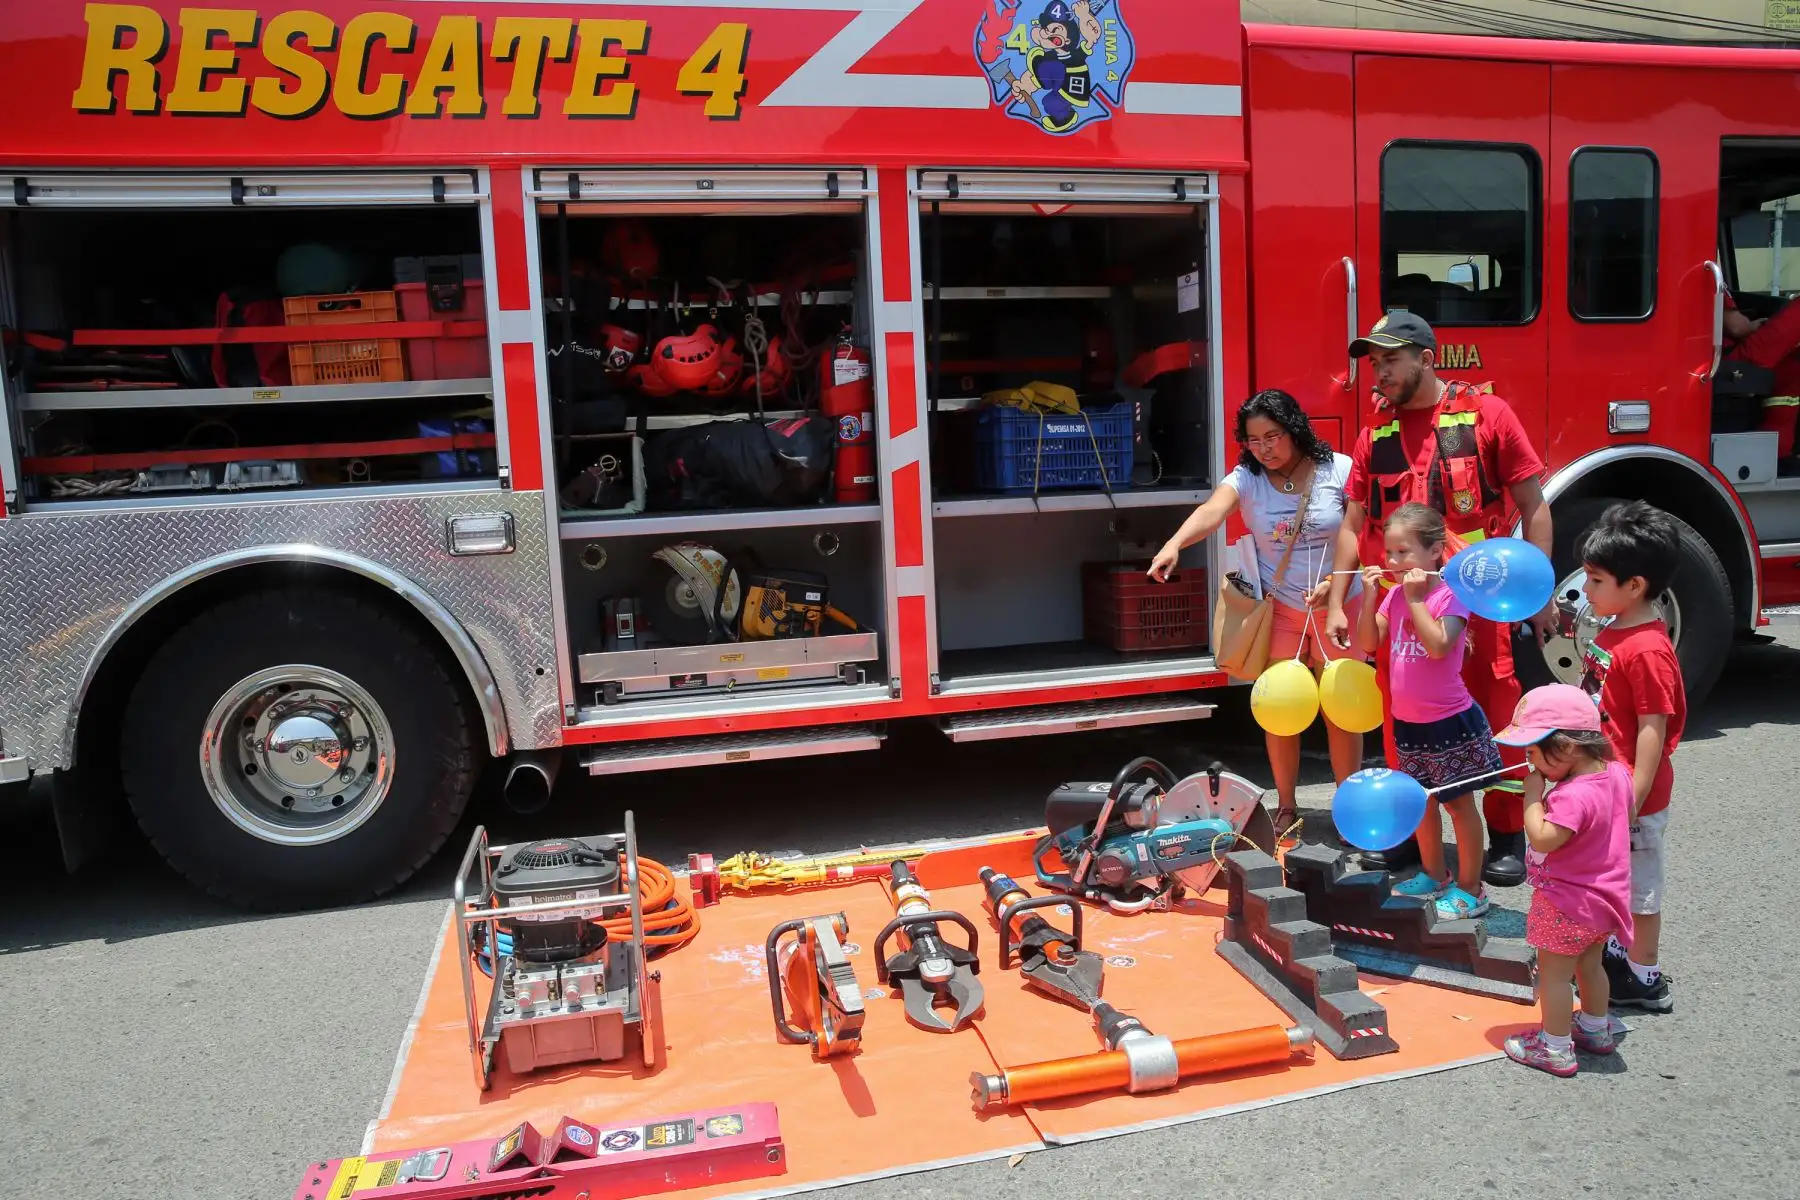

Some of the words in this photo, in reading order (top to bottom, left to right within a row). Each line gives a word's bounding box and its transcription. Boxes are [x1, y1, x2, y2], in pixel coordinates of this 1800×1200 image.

[1050, 4, 1062, 18] 4
[1005, 23, 1031, 54] 4
[1104, 19, 1118, 65] LIMA
[72, 3, 651, 120] RESCATE
[676, 23, 752, 120] 4
[1105, 70, 1119, 82] 4
[1434, 344, 1482, 369] IMA
[534, 894, 572, 903] holmatro
